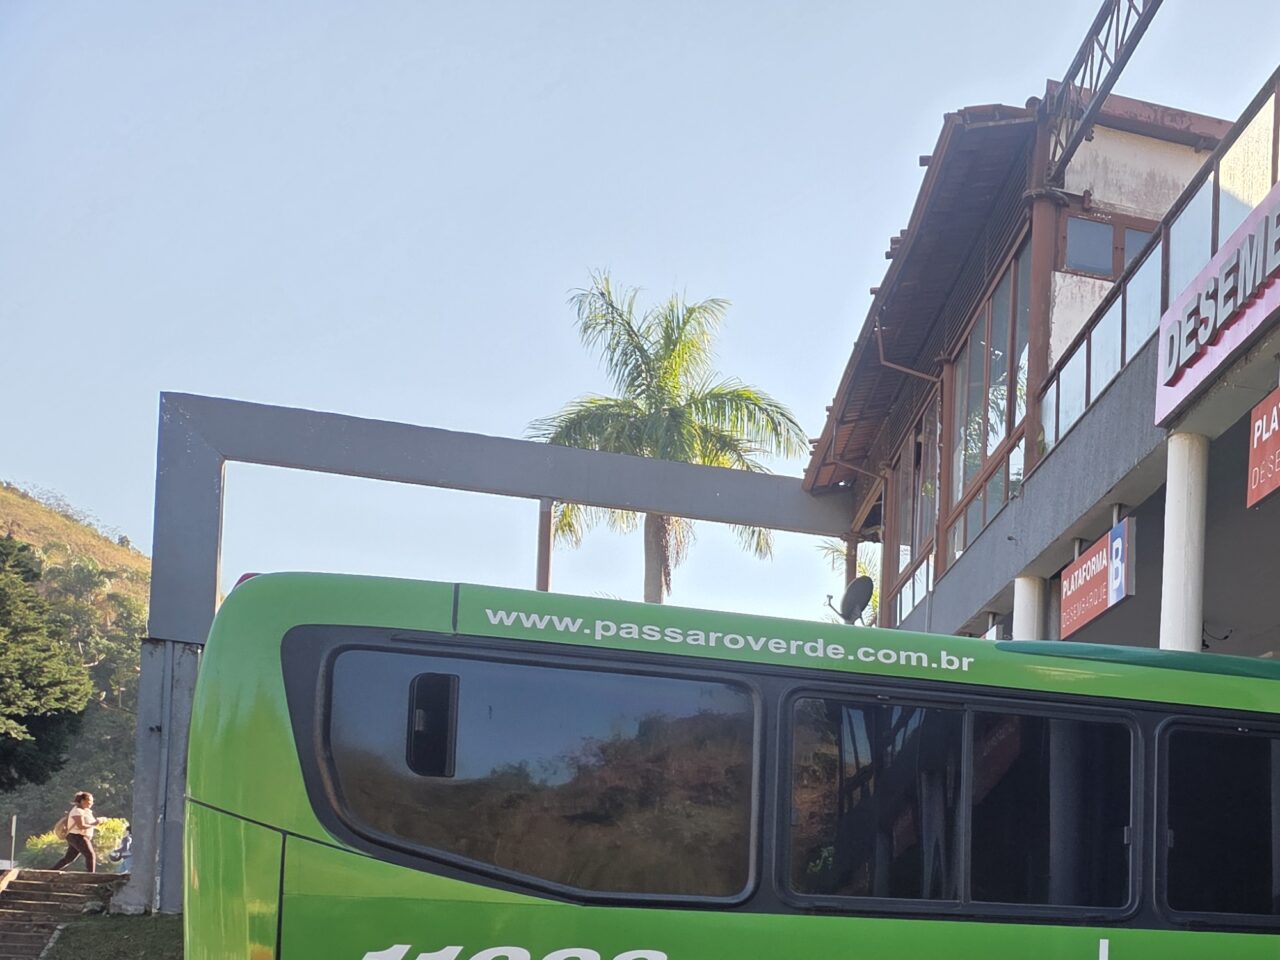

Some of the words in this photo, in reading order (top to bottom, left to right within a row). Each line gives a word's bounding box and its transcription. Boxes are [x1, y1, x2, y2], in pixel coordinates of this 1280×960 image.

[1062, 548, 1107, 599] PLATAFORMA
[1112, 537, 1122, 590] B
[485, 607, 974, 671] www.passaroverde.com.br
